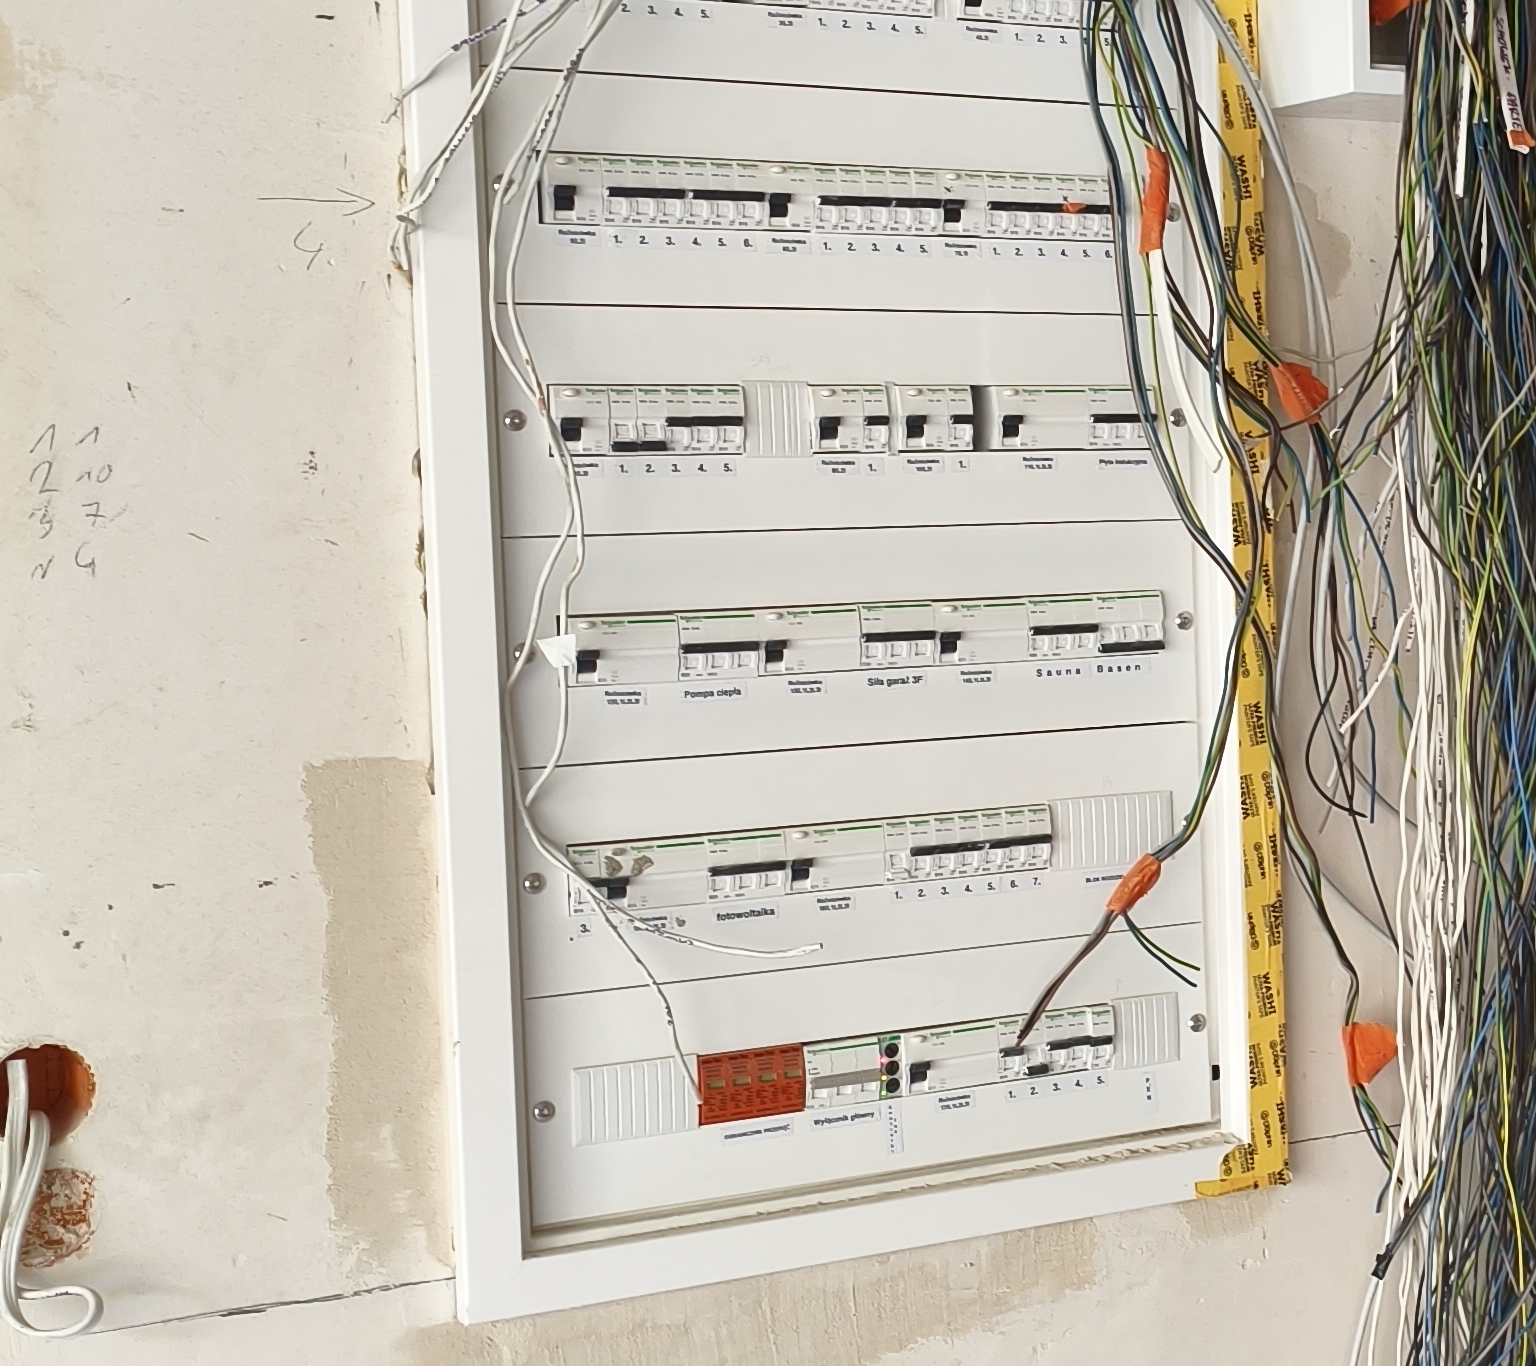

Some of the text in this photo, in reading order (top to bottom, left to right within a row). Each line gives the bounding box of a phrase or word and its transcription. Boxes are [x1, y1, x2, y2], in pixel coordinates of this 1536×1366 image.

[1037, 34, 1045, 43] 2.
[1060, 35, 1067, 44] 3.
[1237, 155, 1252, 199] WASHI
[29, 424, 55, 453] 1
[29, 460, 61, 494] 2
[619, 463, 733, 473] 1. 2. 3. 4. 5.
[81, 502, 108, 527] 7
[1036, 667, 1081, 677] Sauna
[684, 689, 714, 698] Pompa
[1253, 701, 1266, 745] WASHI
[1257, 852, 1266, 879] Dolphin
[1263, 972, 1276, 1014] WASHI
[1262, 1121, 1272, 1147] Dolphin
